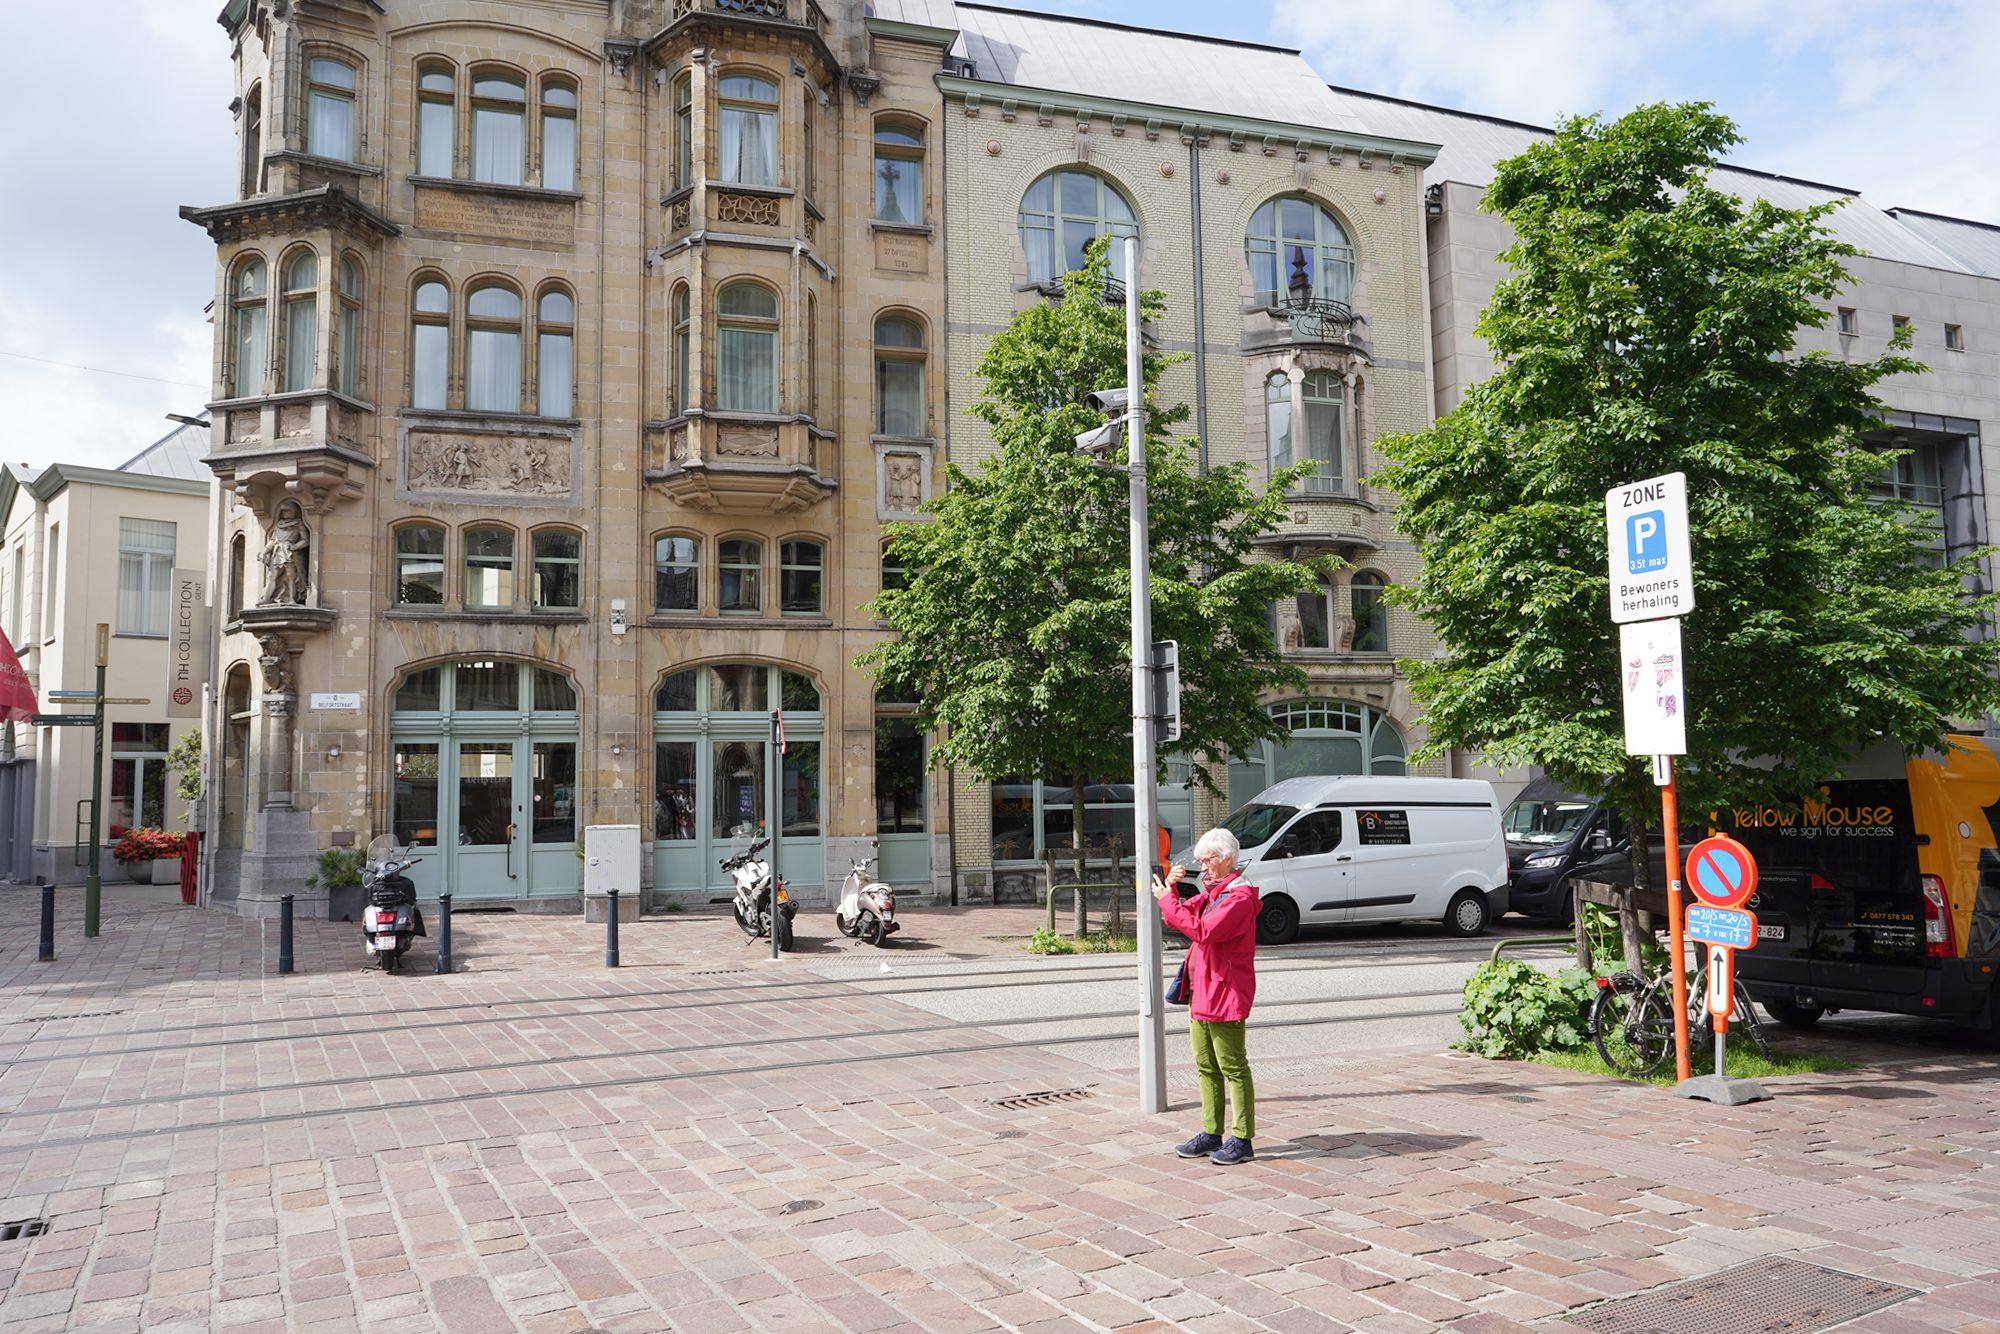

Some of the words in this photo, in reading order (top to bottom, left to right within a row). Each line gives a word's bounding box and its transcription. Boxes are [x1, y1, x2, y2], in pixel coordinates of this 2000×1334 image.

[1623, 482, 1665, 507] ZONE
[1634, 516, 1657, 554] P
[1630, 559, 1646, 571] 3.5t
[1649, 556, 1666, 567] max
[1620, 579, 1679, 597] Bewoners
[1623, 594, 1679, 612] herhaling
[178, 580, 193, 660] COLLECTION
[1732, 804, 1796, 828] Yellow
[1804, 800, 1894, 827] Mouse
[1366, 817, 1376, 830] B
[1780, 828, 1797, 837] we
[1800, 826, 1822, 839] sign
[1826, 825, 1841, 837] for
[1845, 826, 1895, 837] success
[1702, 925, 1711, 937] 7
[1729, 929, 1741, 942] 17
